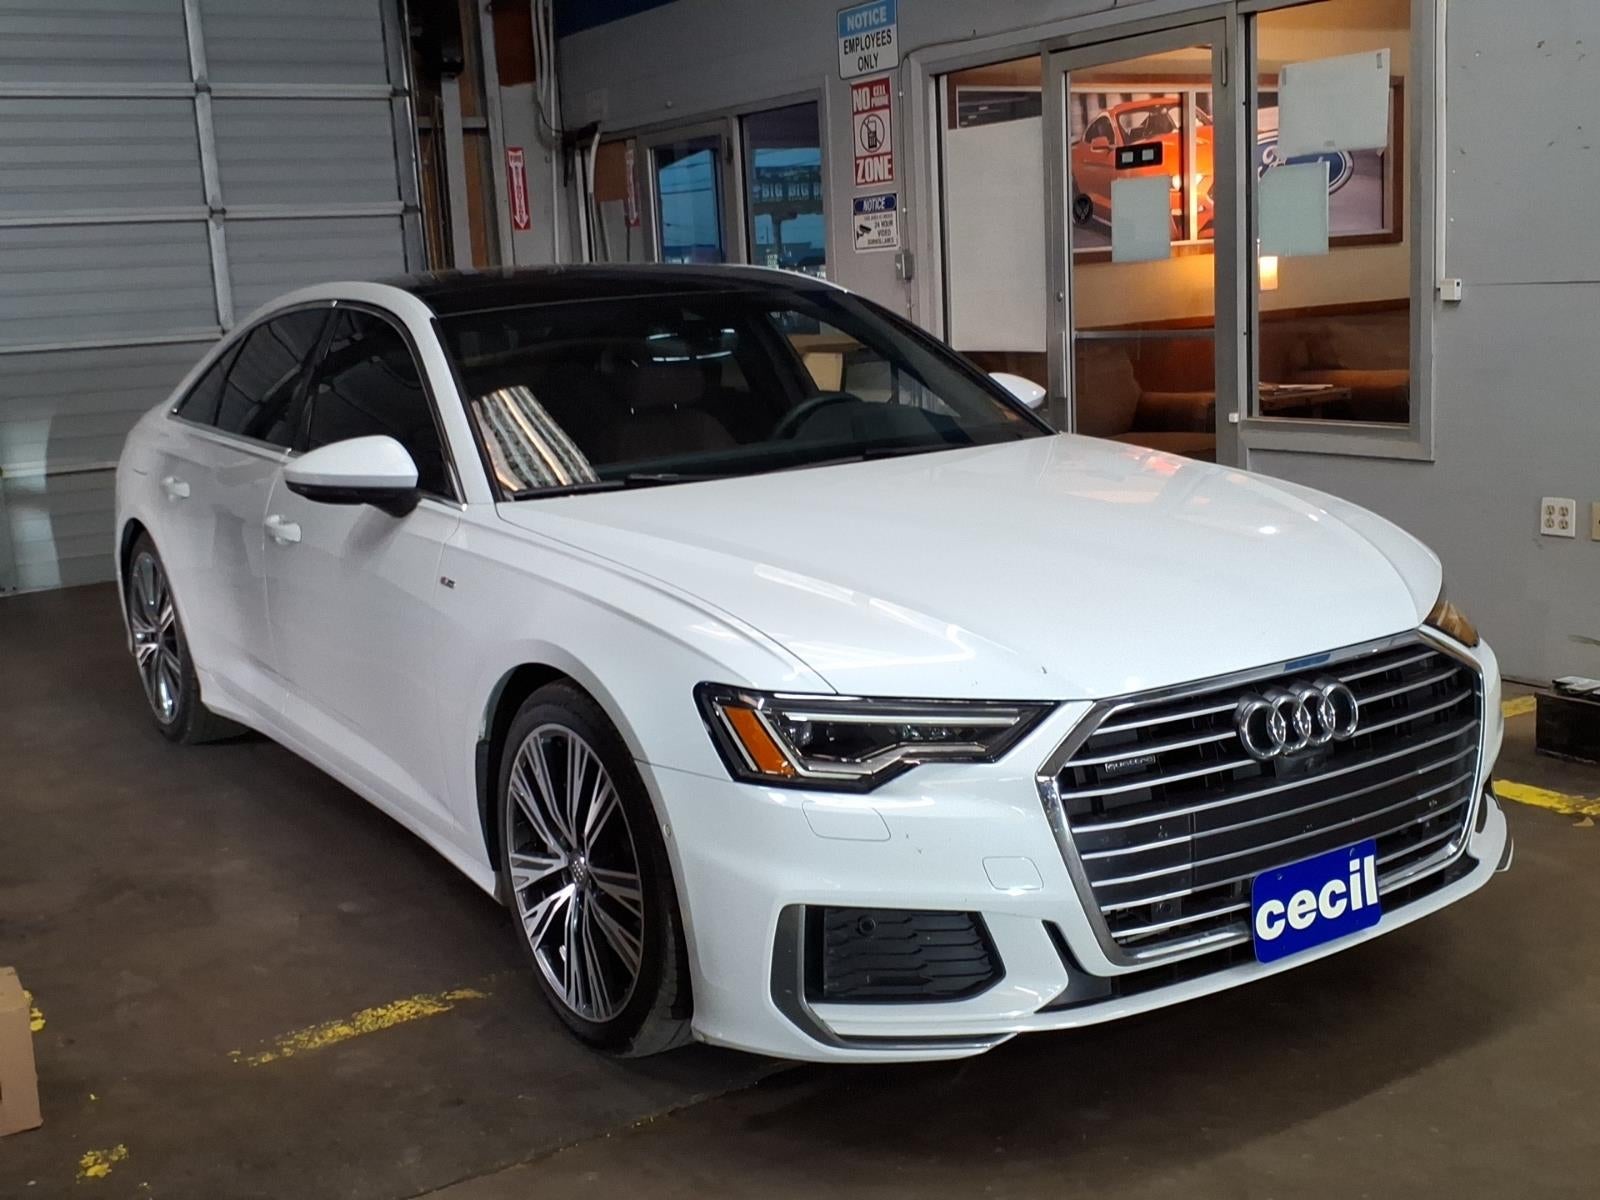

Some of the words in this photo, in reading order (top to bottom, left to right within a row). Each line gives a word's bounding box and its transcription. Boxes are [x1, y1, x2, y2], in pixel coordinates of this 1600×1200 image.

[847, 6, 887, 31] NOTICE
[843, 29, 892, 55] EMPLOYEES
[857, 52, 879, 72] ONLY
[852, 86, 871, 112] NO
[856, 155, 892, 184] ZONE
[863, 197, 885, 212] NOTICE
[1255, 855, 1379, 941] cecil
